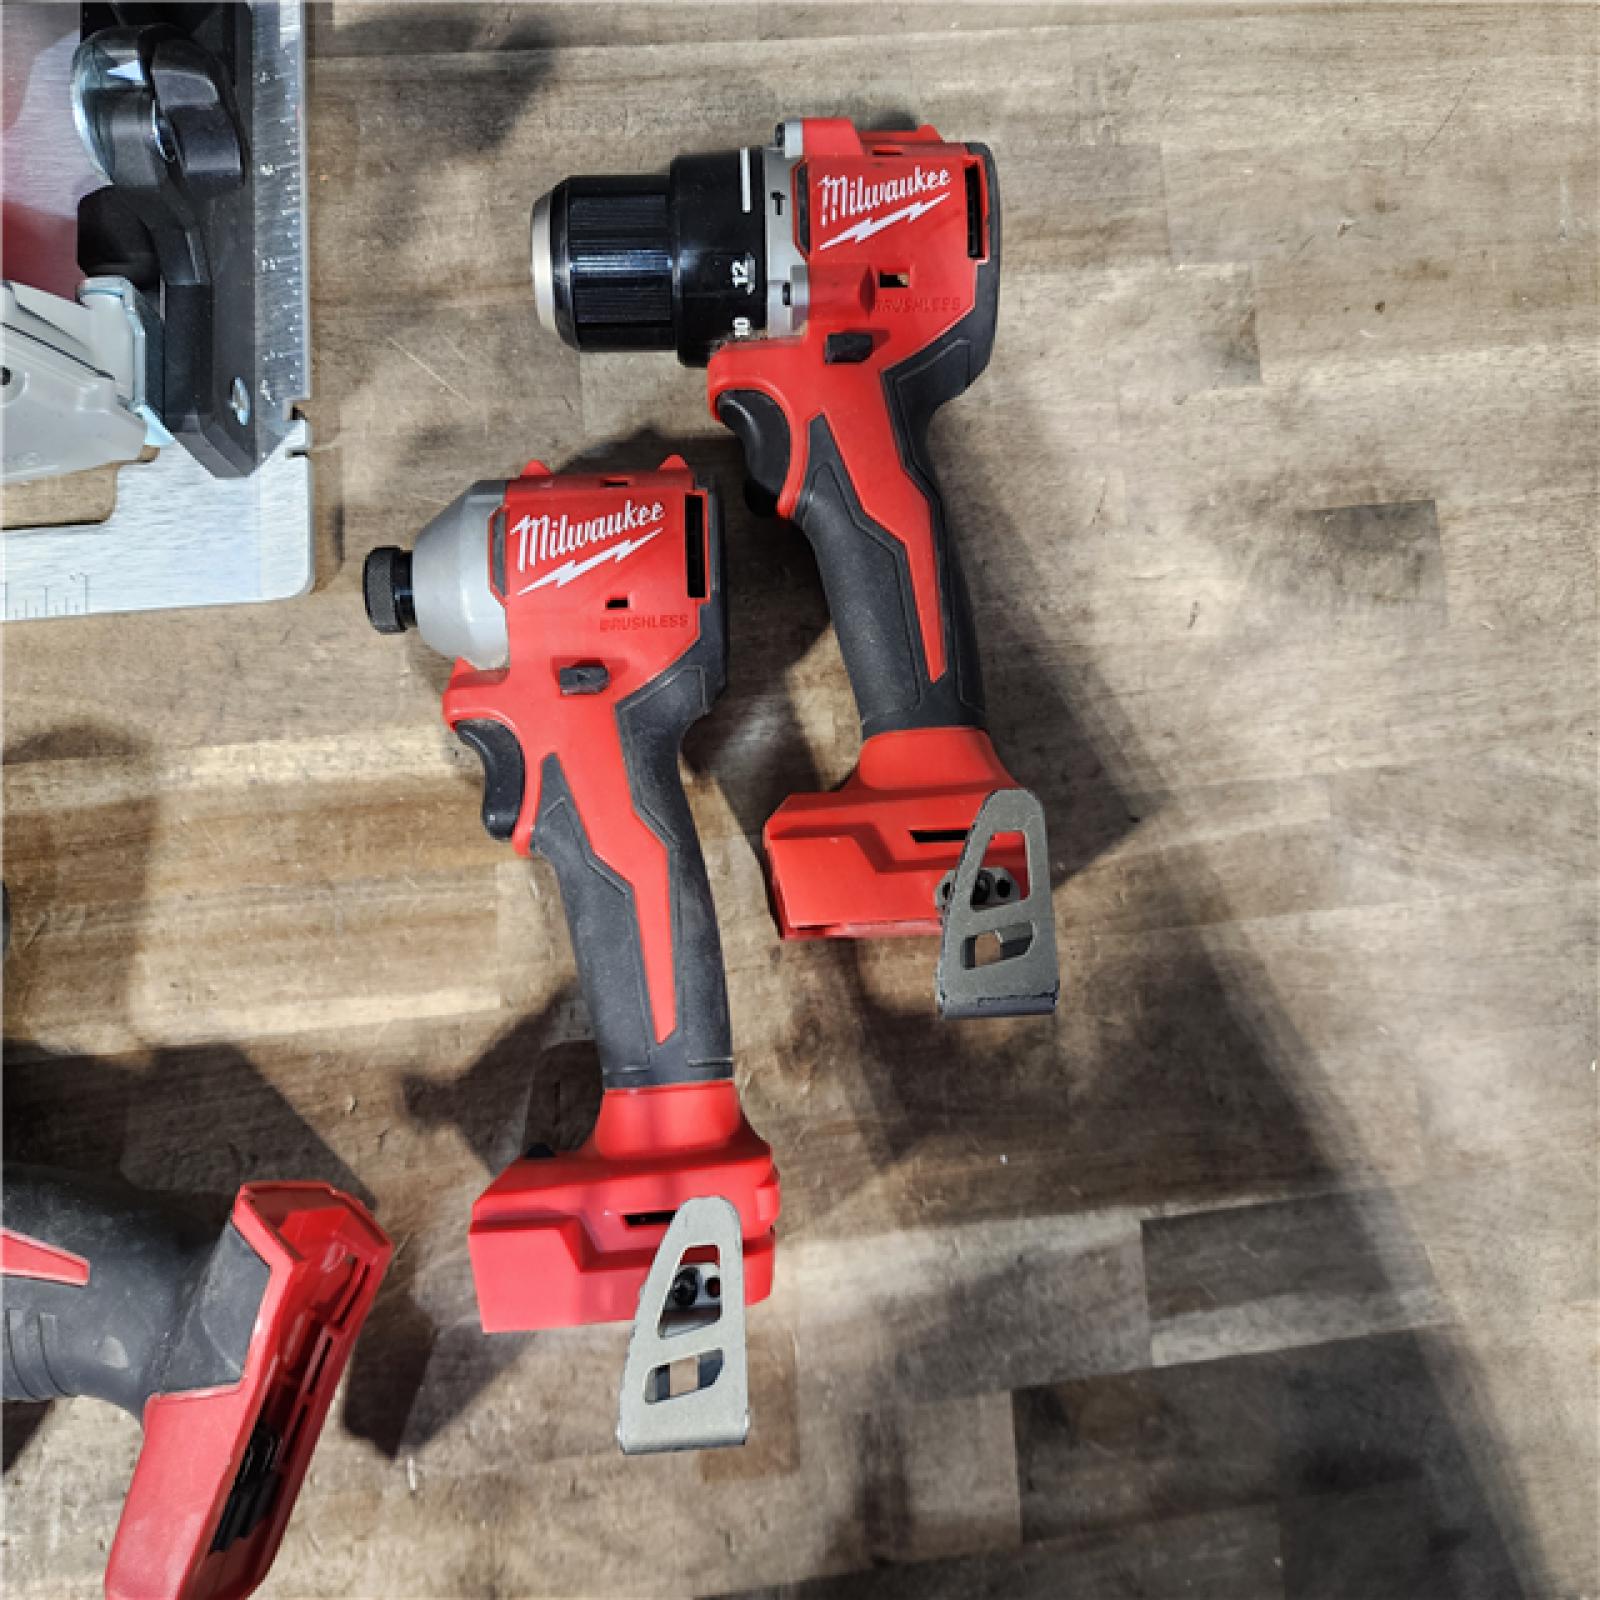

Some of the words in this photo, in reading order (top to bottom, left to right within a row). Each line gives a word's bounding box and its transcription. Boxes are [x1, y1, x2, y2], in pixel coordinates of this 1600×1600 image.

[817, 165, 951, 228] Milwaukee
[732, 260, 748, 288] 12
[733, 317, 750, 337] 10
[509, 499, 665, 573] Milwaukee
[599, 614, 689, 632] BRUSHLESS
